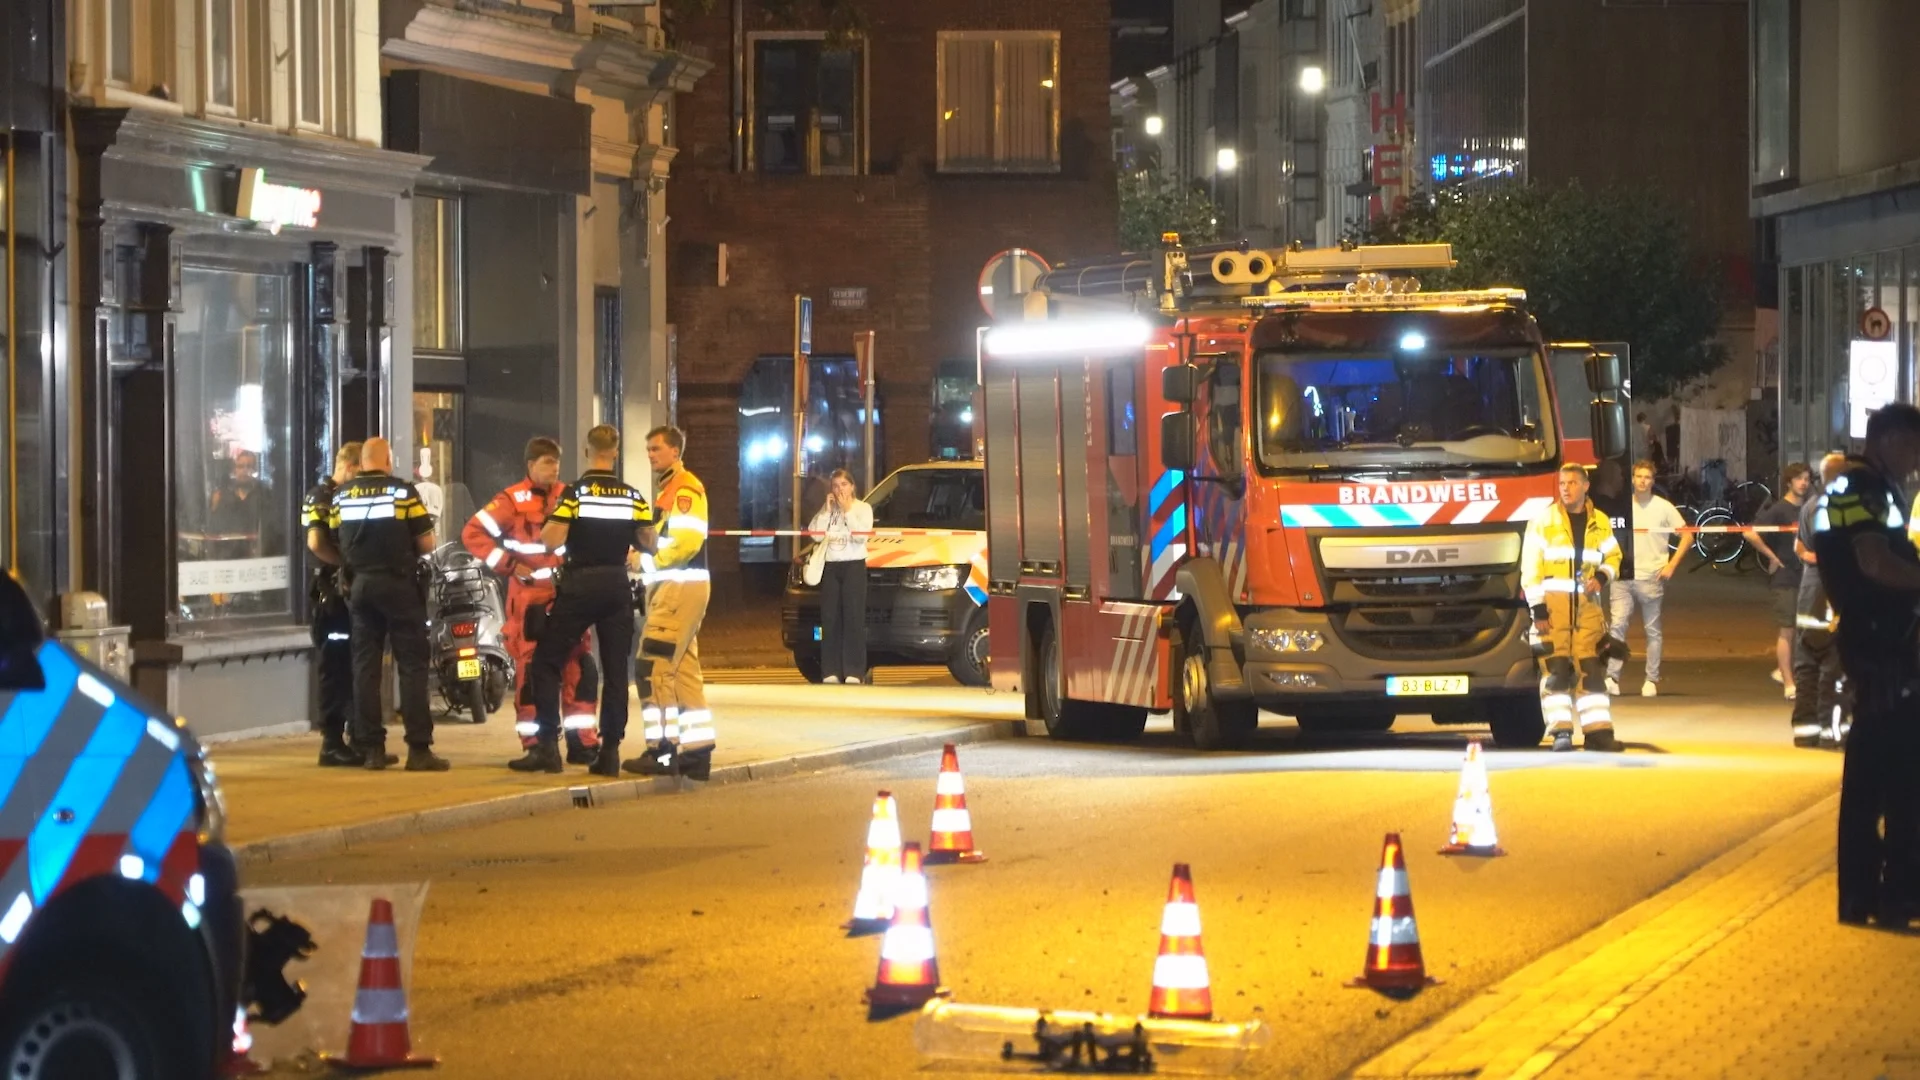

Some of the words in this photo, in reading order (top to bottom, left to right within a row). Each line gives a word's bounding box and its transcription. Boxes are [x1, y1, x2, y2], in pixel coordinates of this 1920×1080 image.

[1338, 482, 1499, 504] BRANDWEER
[1609, 516, 1626, 529] ER
[1386, 548, 1459, 565] DAF
